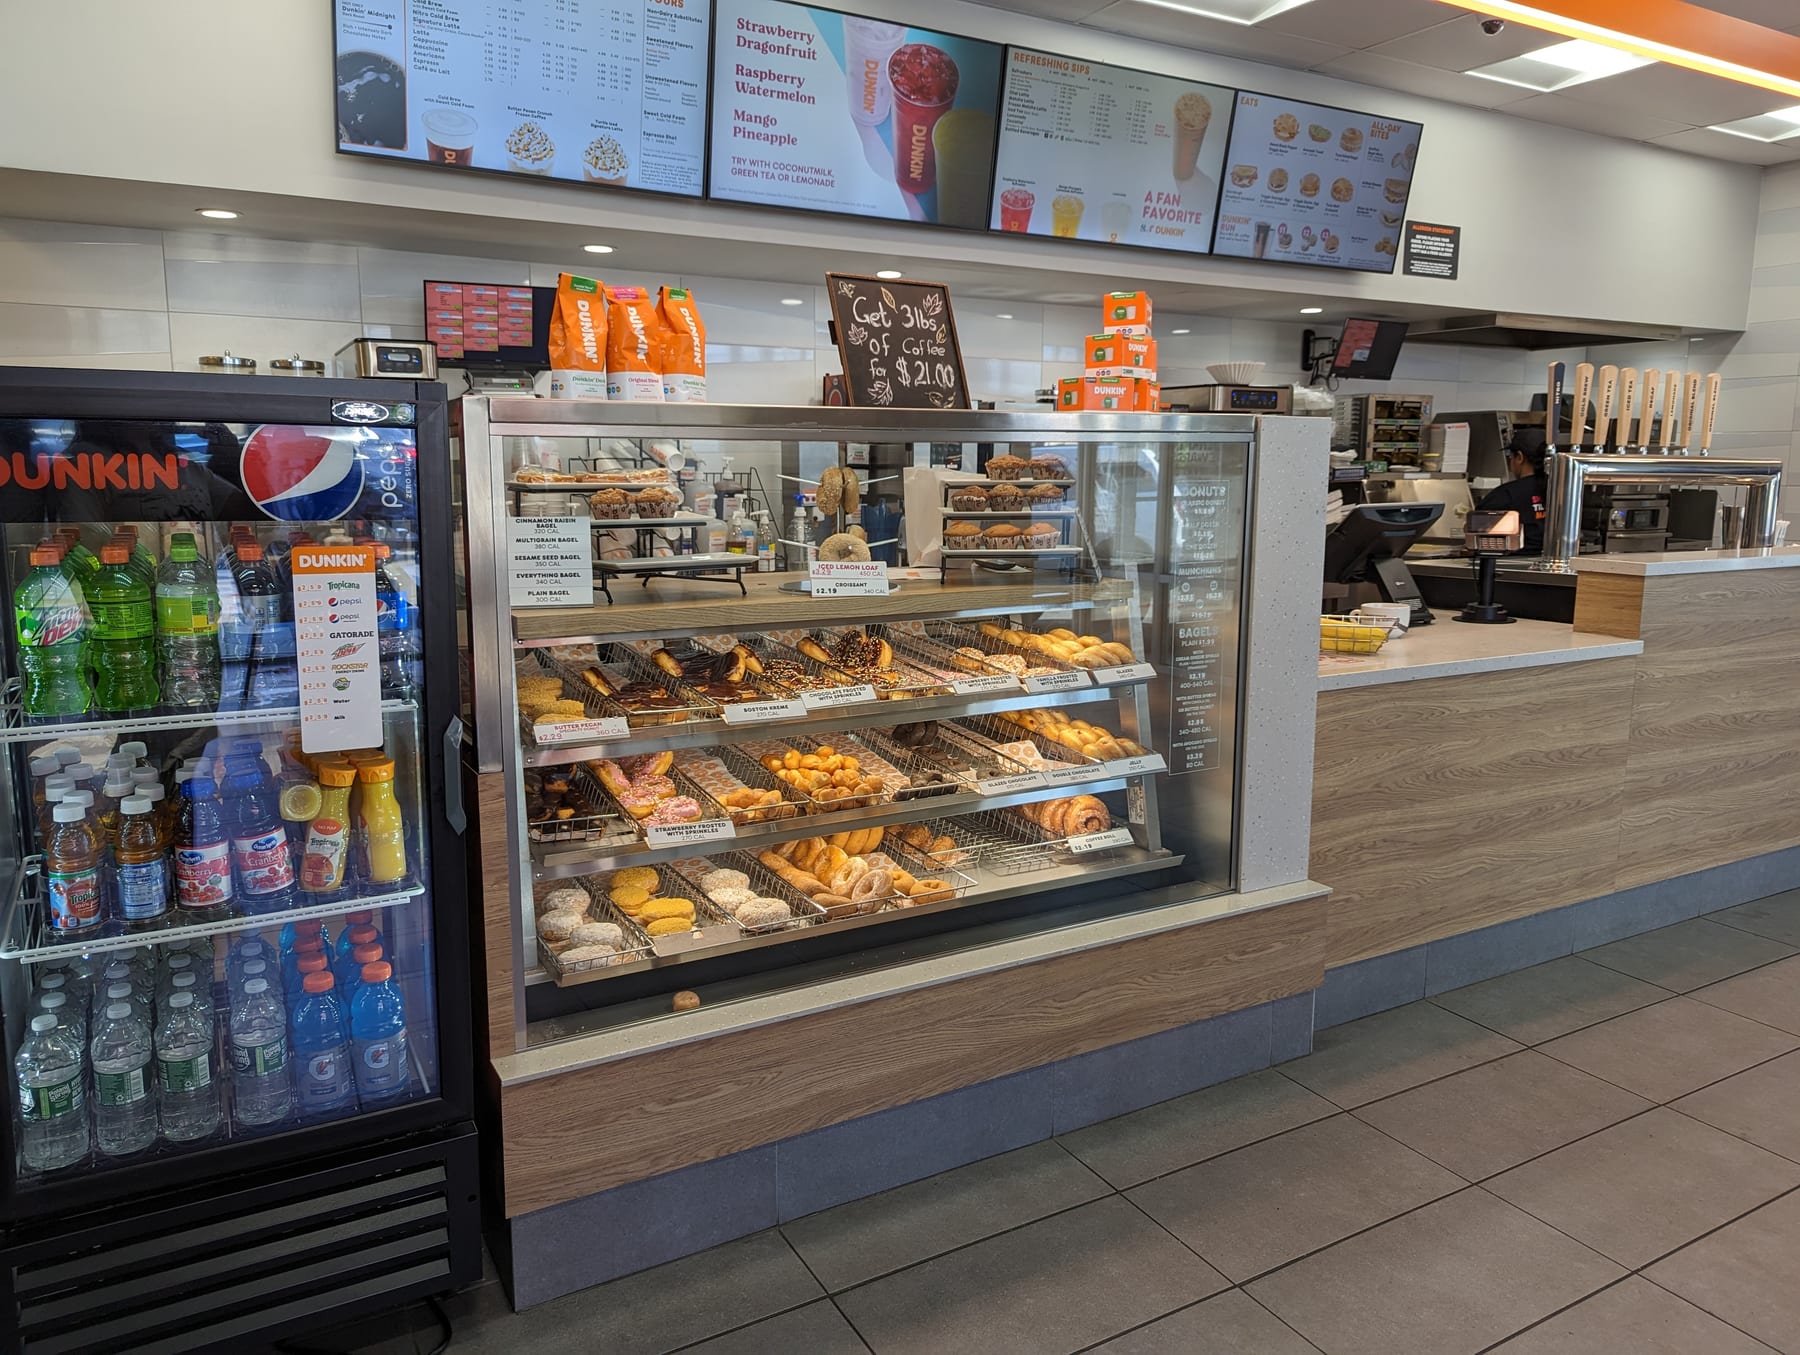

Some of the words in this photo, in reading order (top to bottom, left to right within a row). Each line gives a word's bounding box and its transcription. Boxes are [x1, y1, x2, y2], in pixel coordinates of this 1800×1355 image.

[342, 6, 366, 16] Dunkin'
[368, 10, 396, 20] Midnight
[736, 17, 816, 46] Strawberry
[736, 35, 817, 61] Dragonfruit
[1014, 52, 1070, 71] REFRESHING
[1070, 63, 1090, 75] SIPS
[735, 63, 806, 88] Raspberry
[735, 80, 816, 106] Watermelon
[863, 58, 880, 114] DUNKIN'
[1240, 96, 1259, 108] EATS
[734, 109, 778, 128] Mango
[1370, 129, 1390, 140] BITES
[1371, 121, 1402, 134] ALL-DAY
[732, 126, 798, 146] Pineapple
[909, 124, 928, 182] DUNKIN'
[731, 156, 748, 167] TRY
[748, 158, 771, 170] WITH
[772, 160, 834, 178] COCONUTMILK,
[731, 167, 754, 179] GREEN
[755, 170, 776, 181] TEA
[777, 172, 790, 182] OR
[791, 174, 836, 188] LEMONADE
[1144, 190, 1154, 203] A
[1156, 192, 1182, 206] FAN
[1142, 205, 1202, 225] FAVORITE
[1155, 226, 1186, 238] DUNKIN'
[1220, 224, 1236, 232] RUN
[852, 296, 892, 328] Get
[577, 299, 598, 364] DUNKIN'
[627, 306, 648, 364] DUNKIN'
[680, 307, 702, 369] DUNKIN'
[902, 338, 946, 357] Coffee
[896, 356, 955, 388] $21.00
[1094, 386, 1126, 396] DUNKIN'
[381, 438, 403, 508] peps
[1182, 486, 1226, 496] DONUTS
[299, 554, 368, 568] DUNKIN'
[1178, 566, 1222, 576] MUNCHKINS
[328, 580, 360, 590] Tropicana
[340, 598, 362, 606] pepsi
[330, 630, 374, 639] GATORADE
[1179, 626, 1218, 638] BAGELS
[331, 662, 368, 670] ROCKSTAR
[958, 678, 990, 686] STRAWBERRY
[982, 680, 1008, 688] SPRINKLES
[809, 688, 842, 698] CHOCOLATE
[842, 686, 866, 694] FROSTED
[834, 692, 862, 700] SPRINKLES
[1072, 768, 1100, 776] CHOCOLATE
[1008, 776, 1038, 784] CHOCOLATE
[654, 824, 696, 832] STRAWBERRY
[248, 846, 288, 867] Cranberry
